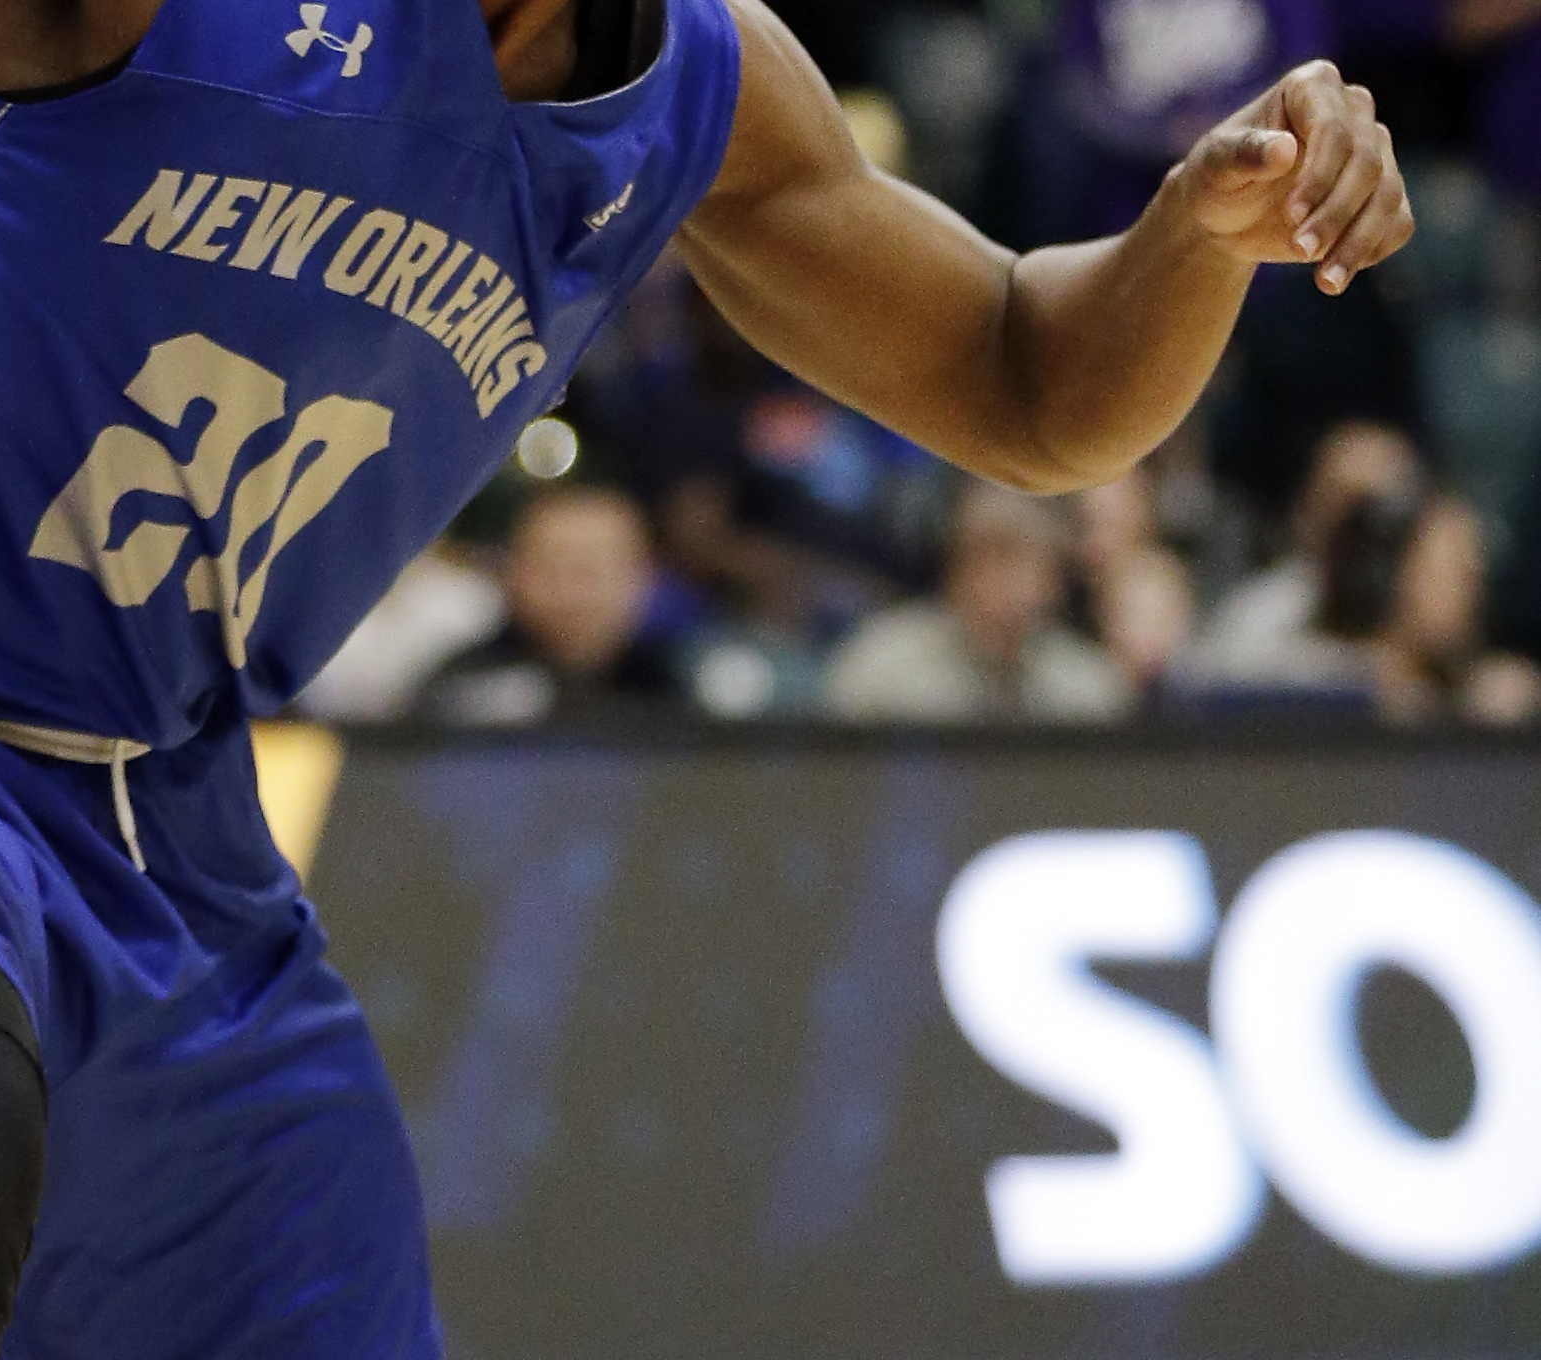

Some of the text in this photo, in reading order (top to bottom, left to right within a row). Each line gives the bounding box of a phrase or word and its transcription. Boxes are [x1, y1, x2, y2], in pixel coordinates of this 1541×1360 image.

[103, 168, 548, 419] NEW ORLEANS
[28, 333, 394, 670] 20
[934, 826, 1541, 1287] SO
